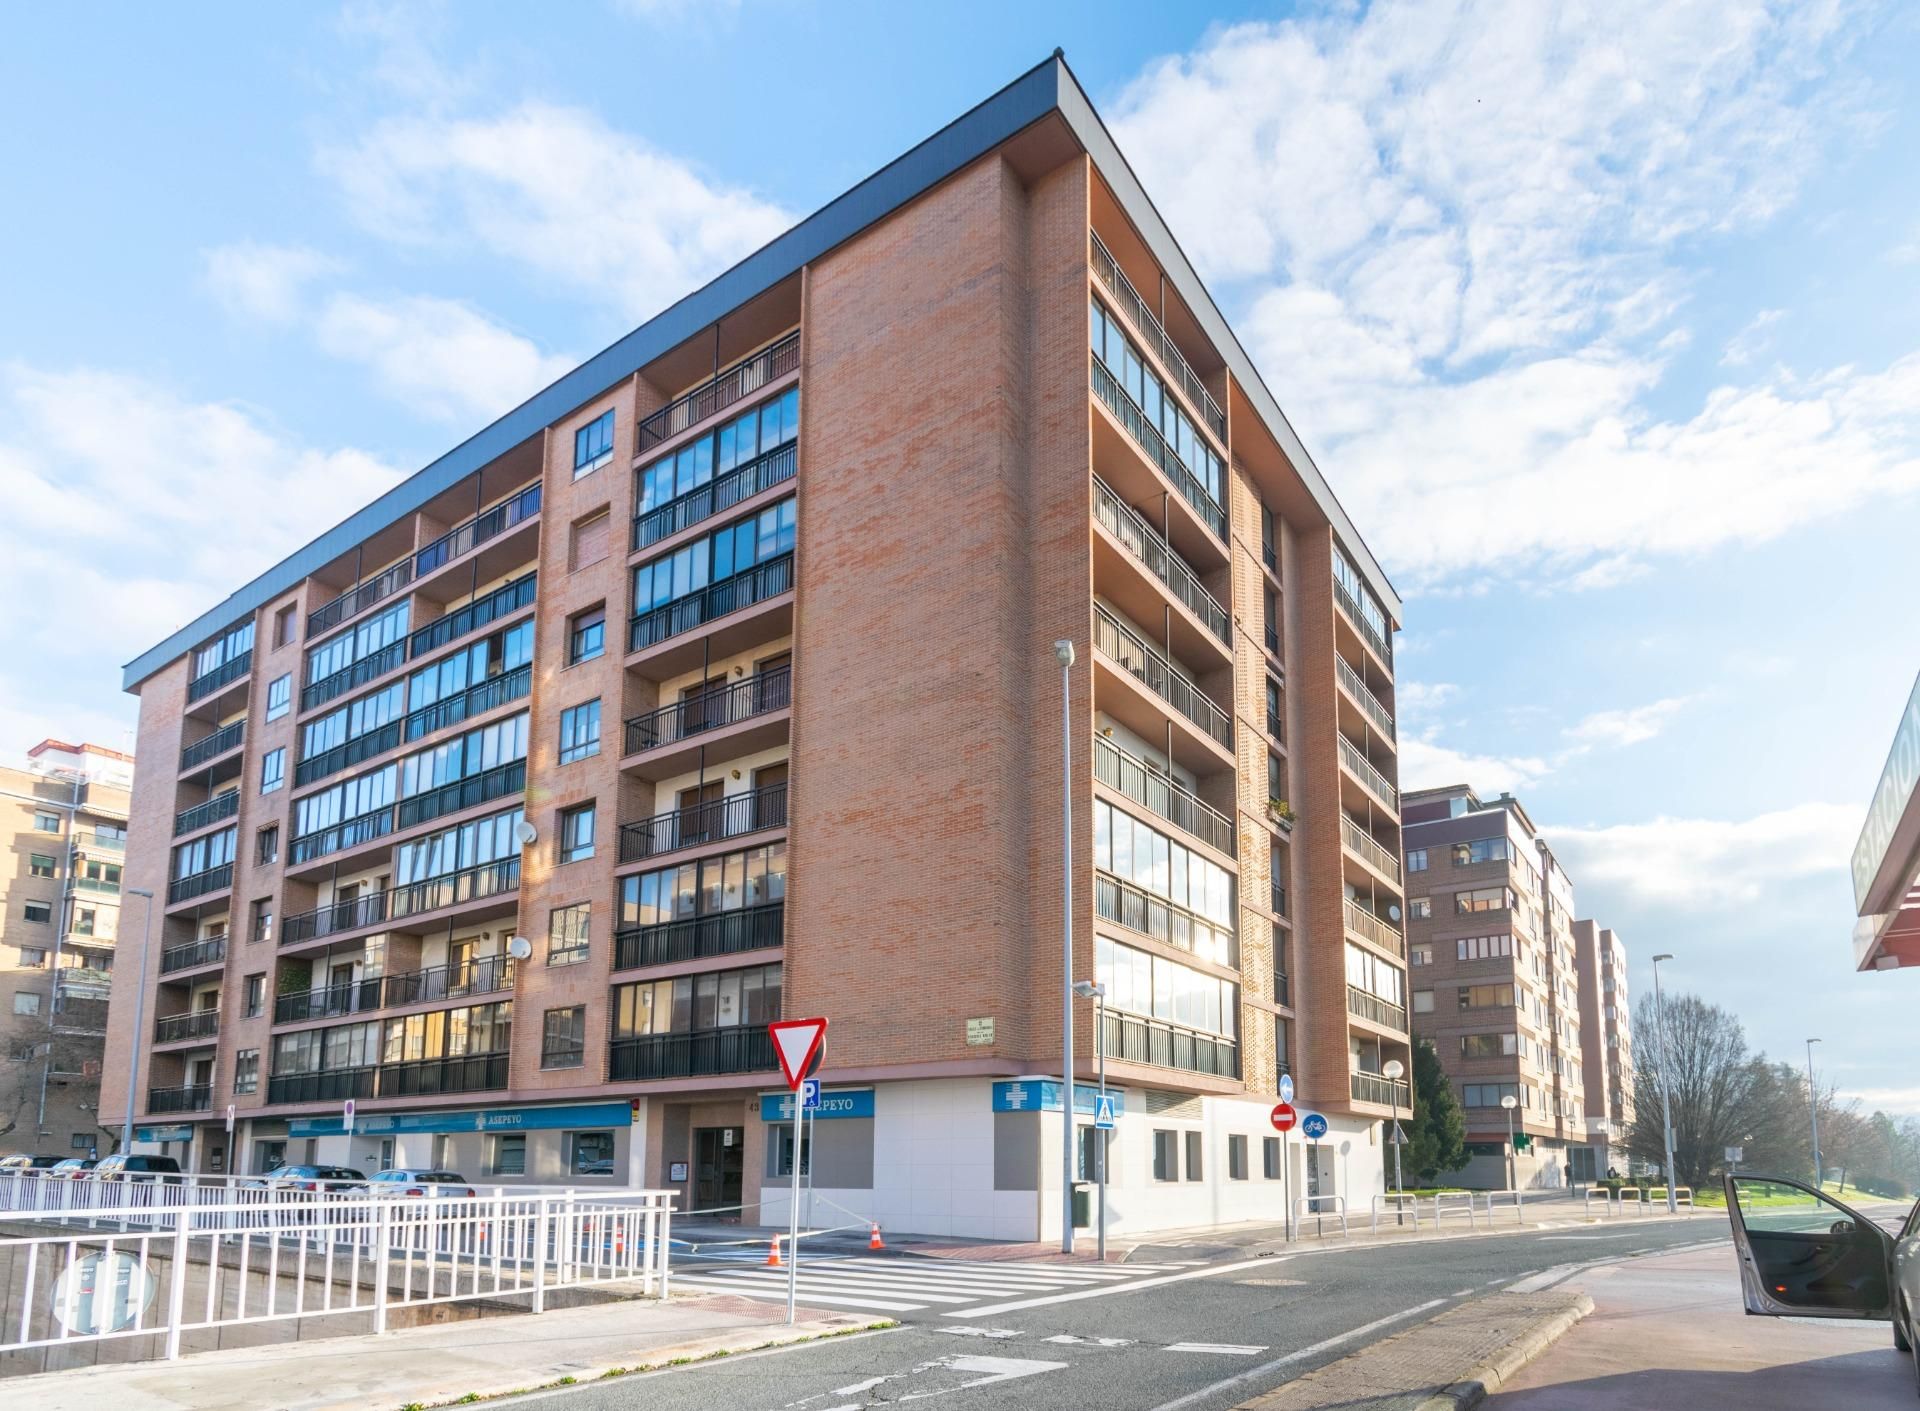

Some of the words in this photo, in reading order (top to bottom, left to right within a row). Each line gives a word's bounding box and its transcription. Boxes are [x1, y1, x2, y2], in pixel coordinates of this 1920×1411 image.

[802, 1082, 816, 1105] P
[804, 1098, 853, 1111] PEYO
[488, 1114, 522, 1125] ASEPEYO
